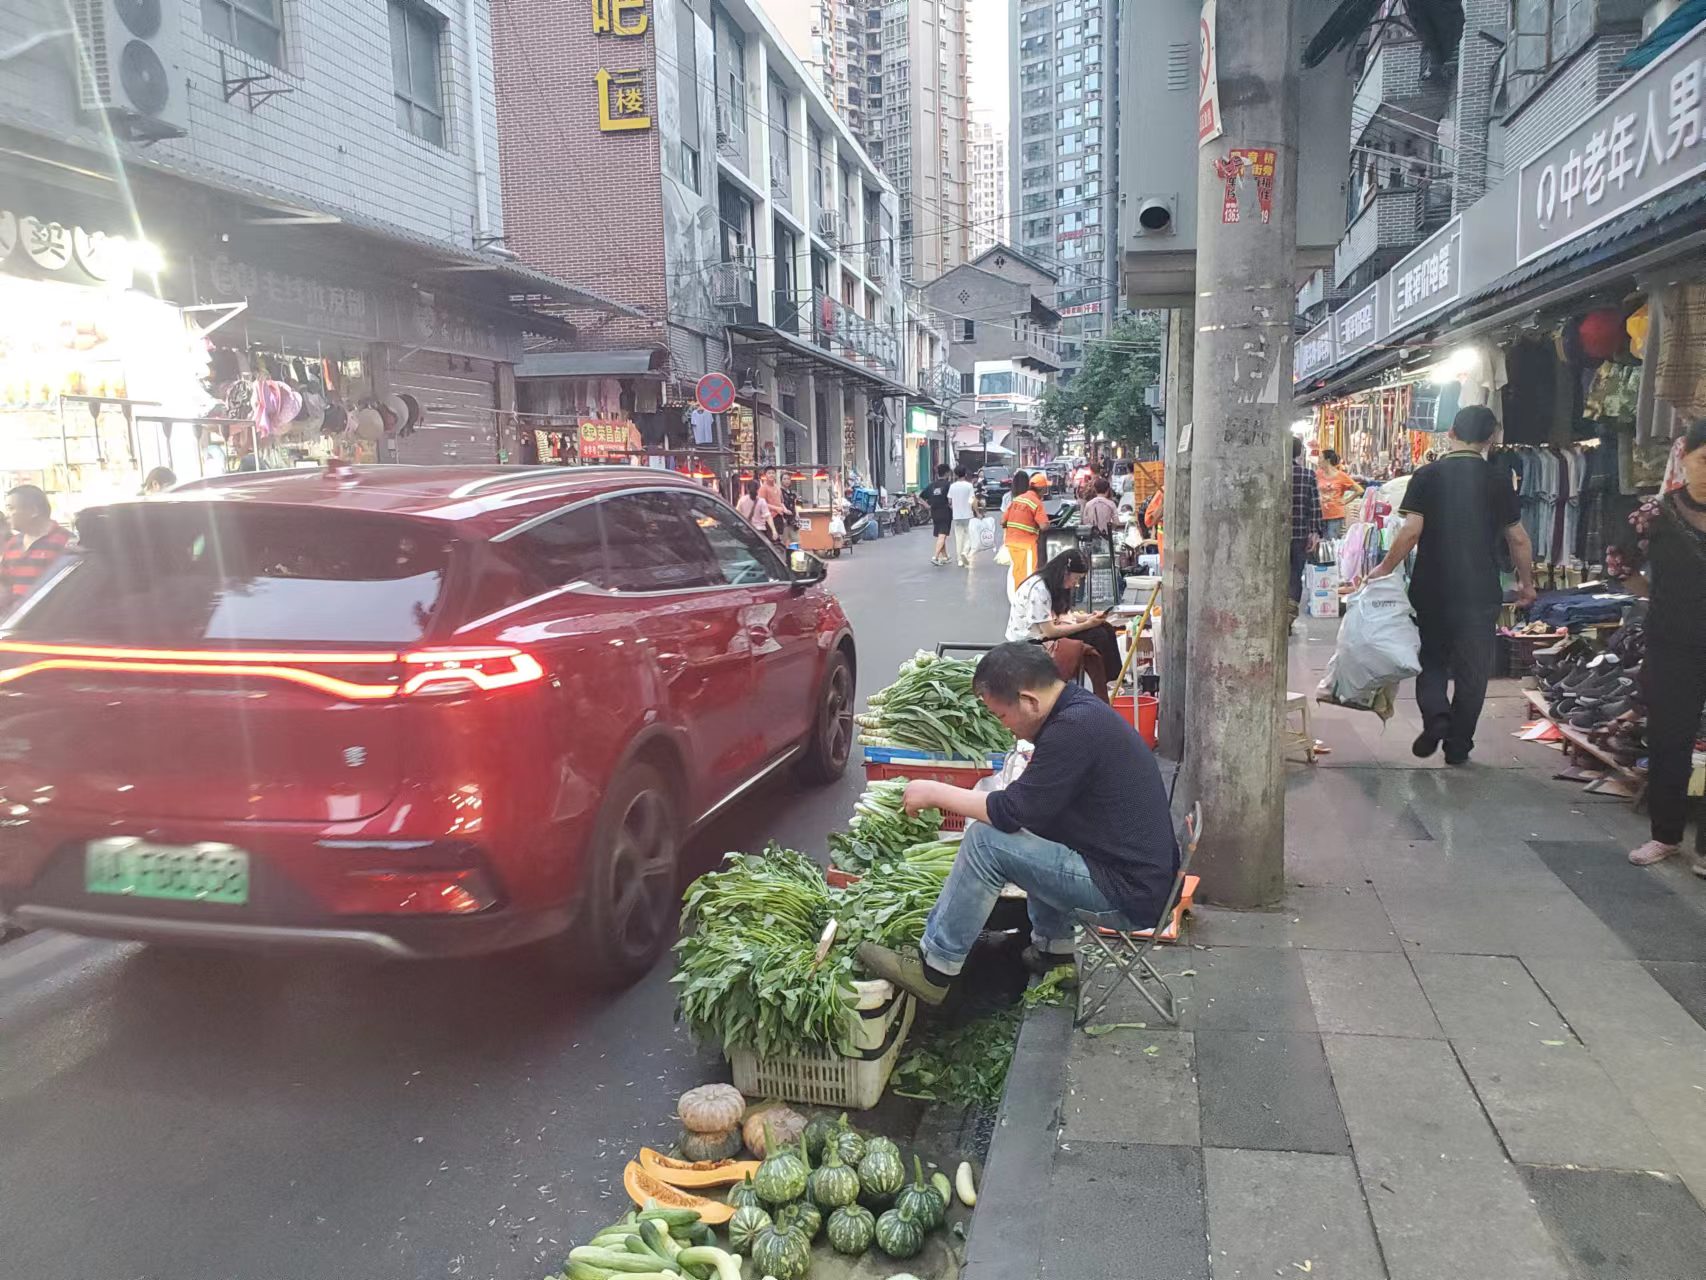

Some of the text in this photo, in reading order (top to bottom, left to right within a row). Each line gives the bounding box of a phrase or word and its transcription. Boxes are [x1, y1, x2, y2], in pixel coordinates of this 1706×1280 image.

[1560, 58, 1706, 220] 中老年人男
[1397, 243, 1451, 312] 三联平价电器
